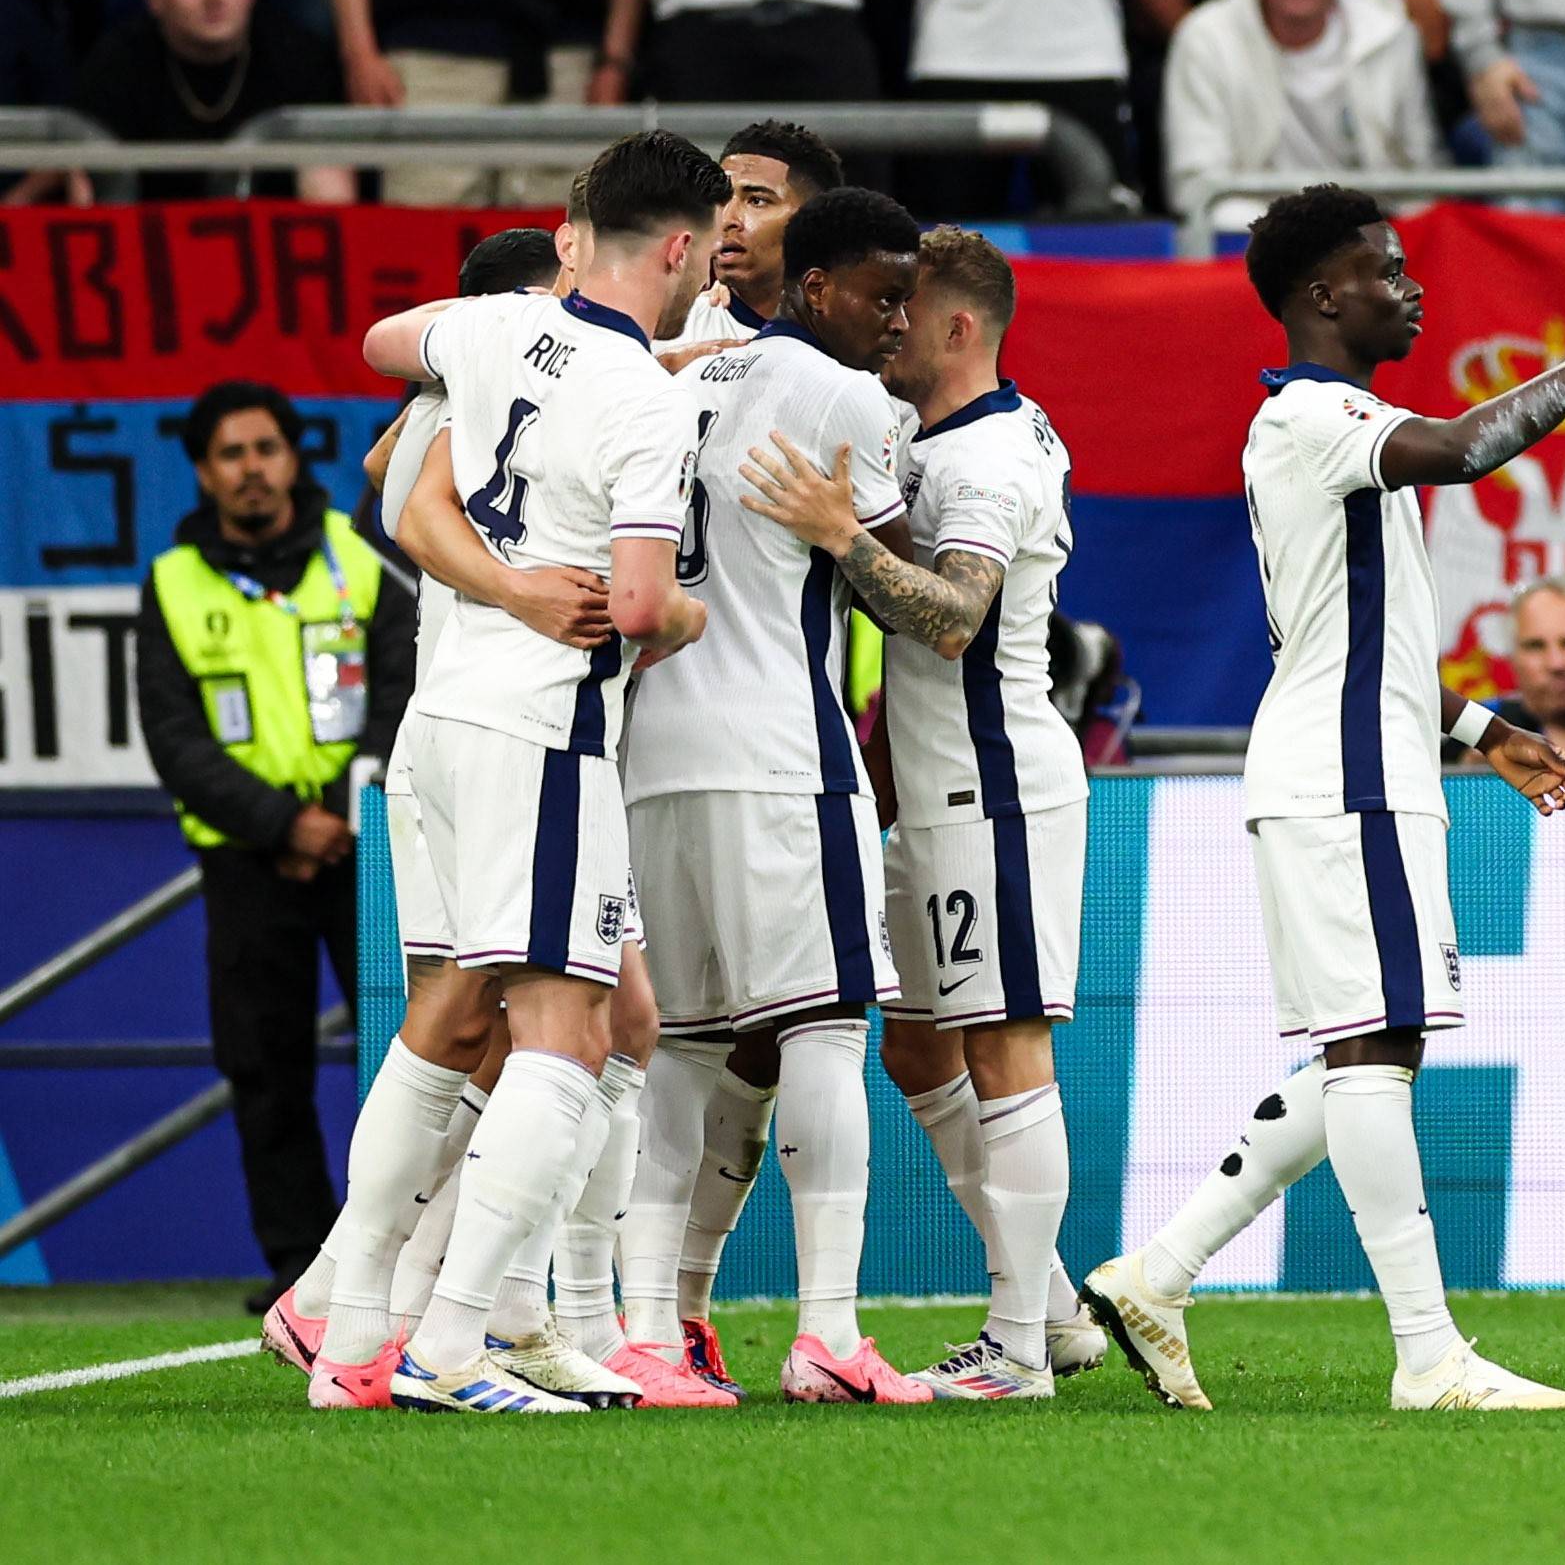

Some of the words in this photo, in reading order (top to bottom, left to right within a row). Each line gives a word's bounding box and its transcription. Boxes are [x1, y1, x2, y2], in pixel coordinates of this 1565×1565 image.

[523, 332, 577, 379] RICE
[700, 353, 763, 383] GUEHI
[466, 395, 541, 565] 4
[926, 888, 984, 969] 12
